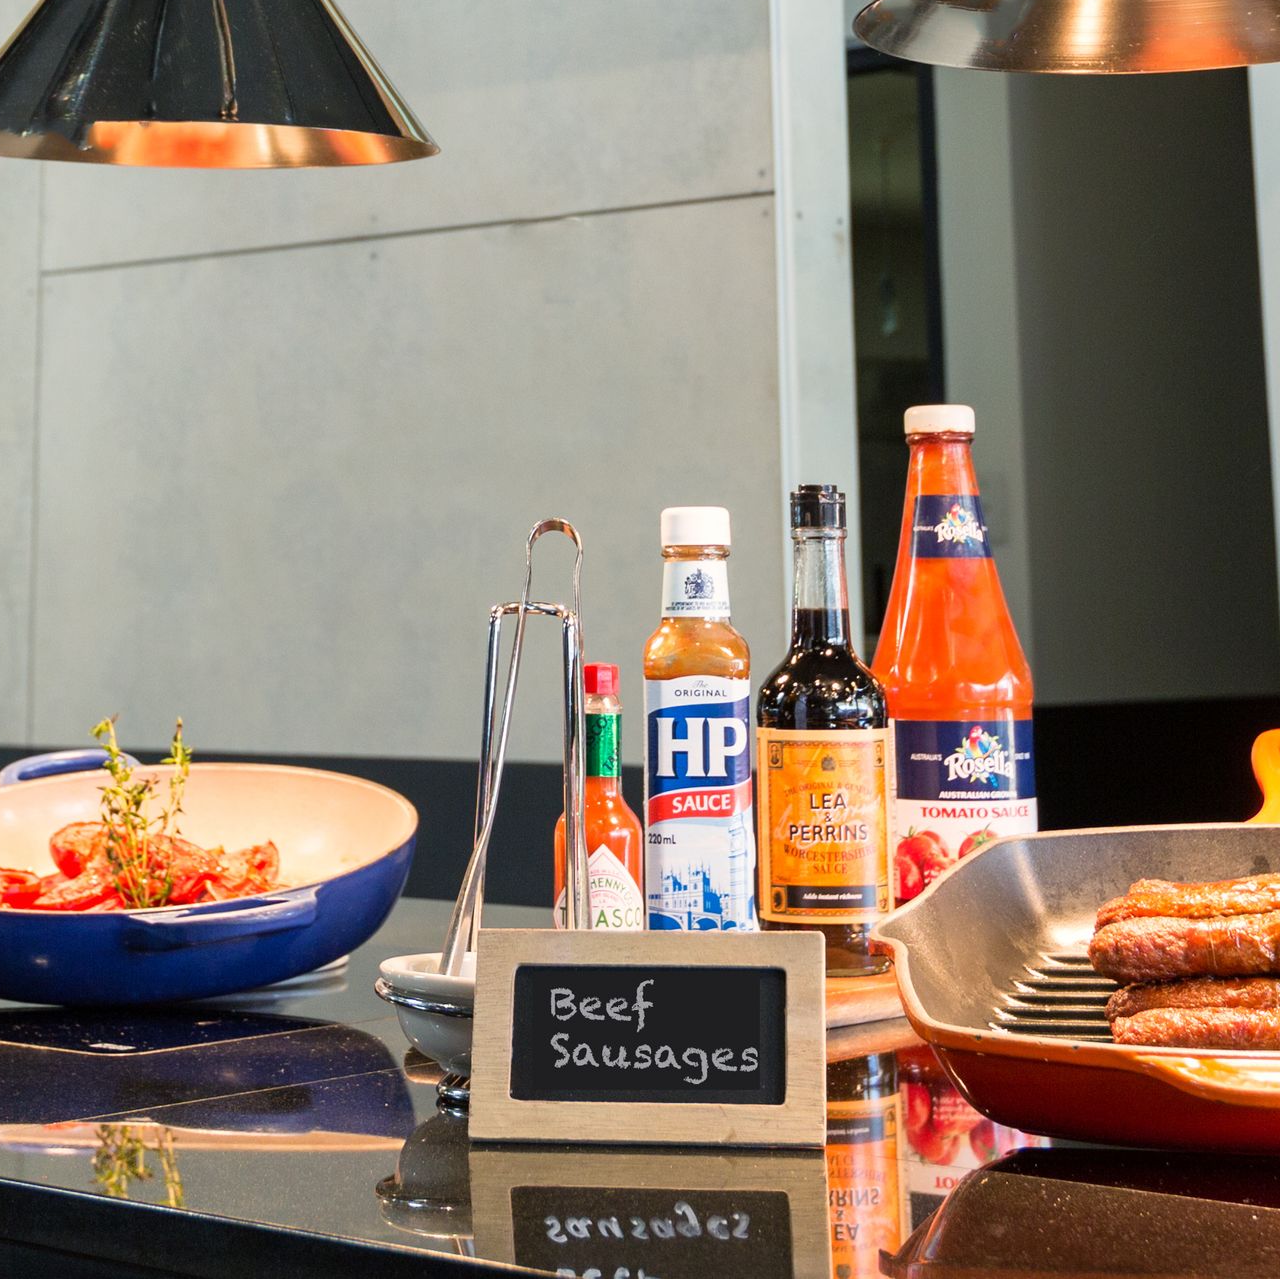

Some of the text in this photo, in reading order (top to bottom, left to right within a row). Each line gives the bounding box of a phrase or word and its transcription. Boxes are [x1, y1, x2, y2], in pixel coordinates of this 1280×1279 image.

[934, 520, 984, 543] Rosella
[674, 689, 727, 698] ORIGINAL
[656, 717, 748, 778] HP
[943, 750, 1015, 782] Rosella
[799, 782, 833, 792] ORIGINAL
[939, 790, 990, 799] AUSTRALIAN
[672, 793, 732, 815] SAUCE
[810, 793, 846, 810] LEA
[824, 812, 833, 822] &
[920, 805, 1030, 819] TOMATO SAUCE
[789, 824, 868, 842] PERRINS
[784, 842, 877, 862] WORCESTERSHIRE
[813, 863, 849, 874] SAUCE
[590, 877, 627, 893] HENNY
[560, 906, 641, 928] TASCO
[550, 978, 655, 1033] Beef
[550, 1032, 759, 1085] Sausages
